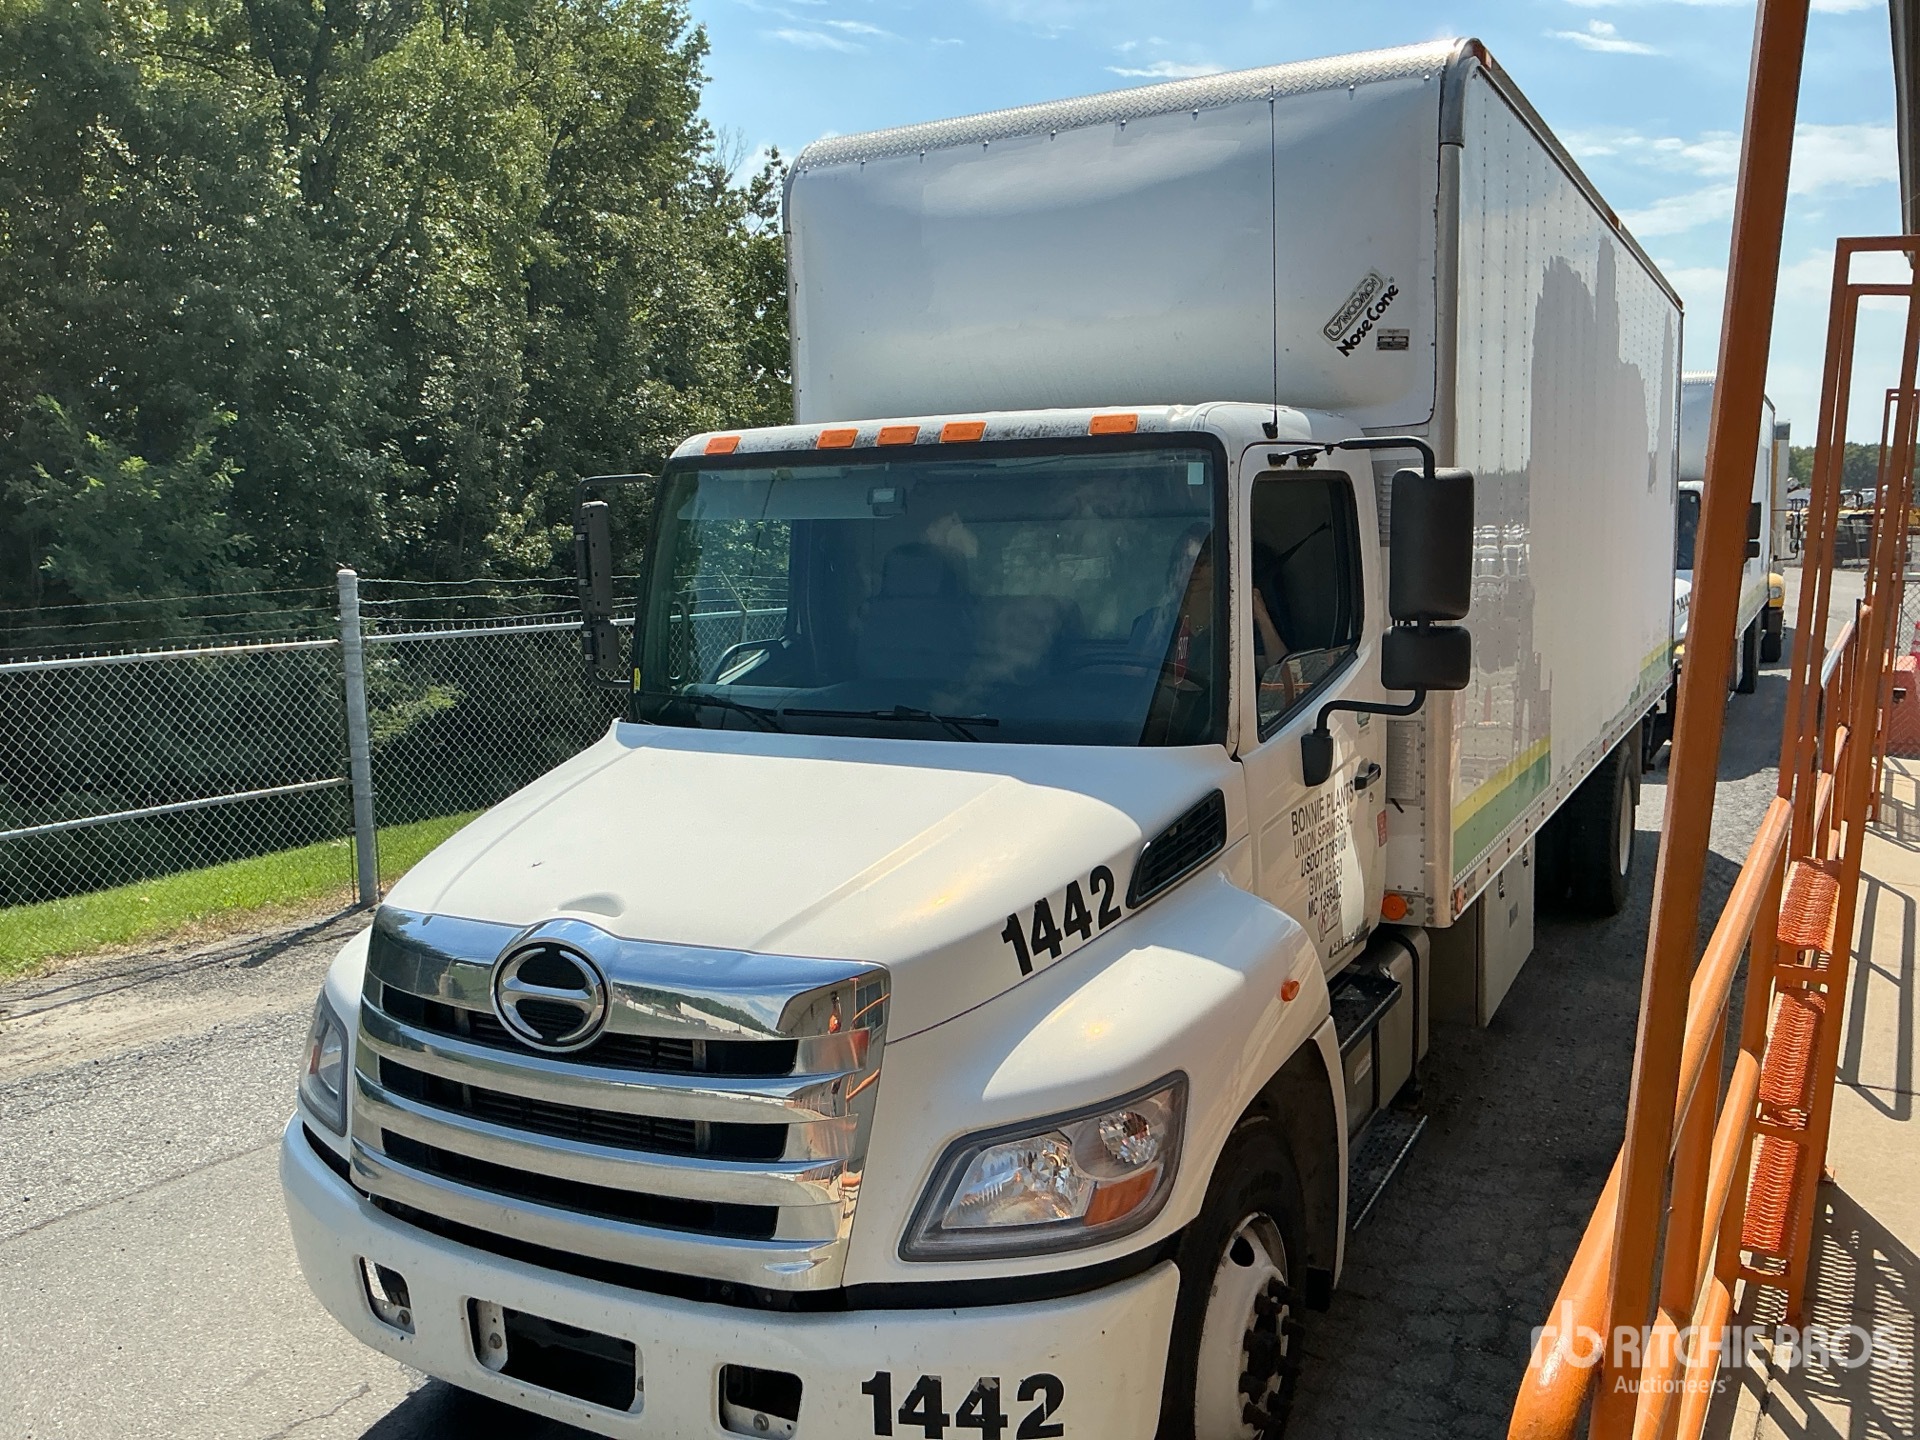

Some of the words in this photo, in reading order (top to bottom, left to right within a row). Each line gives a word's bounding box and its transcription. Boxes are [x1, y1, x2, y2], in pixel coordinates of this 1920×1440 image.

[1336, 319, 1373, 357] Nose
[1366, 284, 1399, 322] Cone
[1291, 796, 1325, 836] BONNIE
[1327, 779, 1354, 816] PLANTS
[1294, 829, 1317, 859] UNION
[1301, 846, 1324, 877] USDOT
[1308, 870, 1324, 896] GVW
[1001, 865, 1122, 977] 1442
[1308, 896, 1318, 920] MC
[861, 1370, 1064, 1440] 1442
